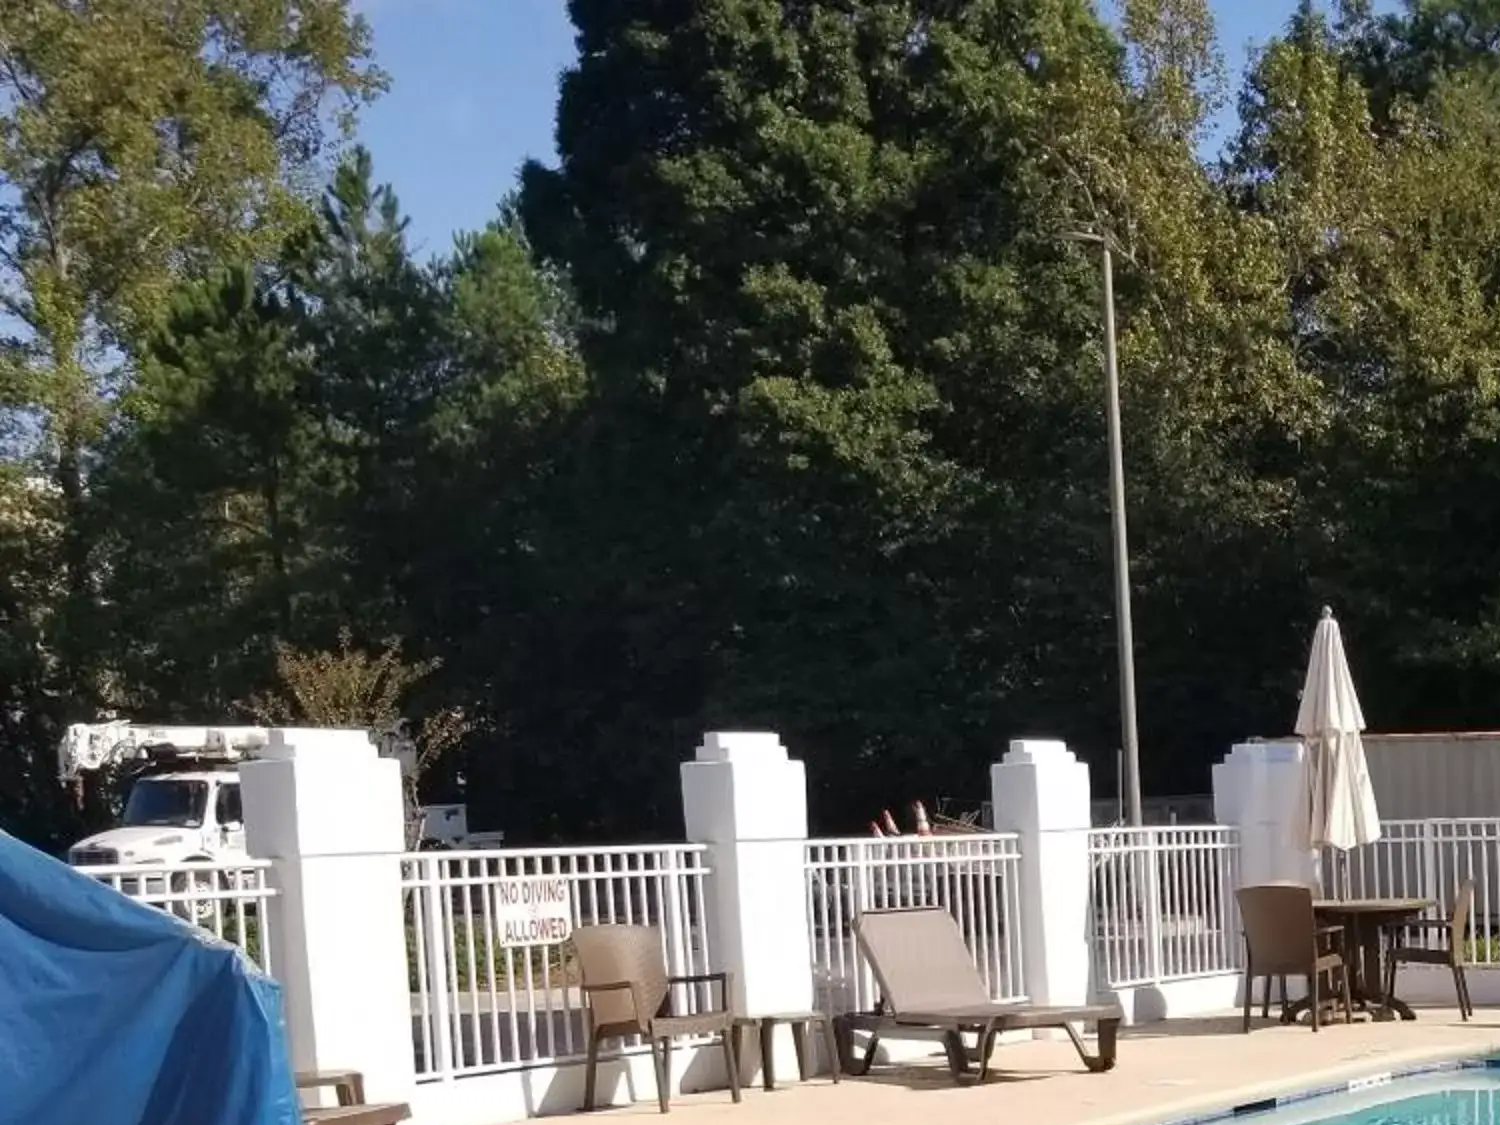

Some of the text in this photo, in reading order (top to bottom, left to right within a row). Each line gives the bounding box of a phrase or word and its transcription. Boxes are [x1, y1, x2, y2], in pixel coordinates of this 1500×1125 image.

[500, 879, 567, 905] NO DIVING
[505, 917, 567, 942] ALLOWED
